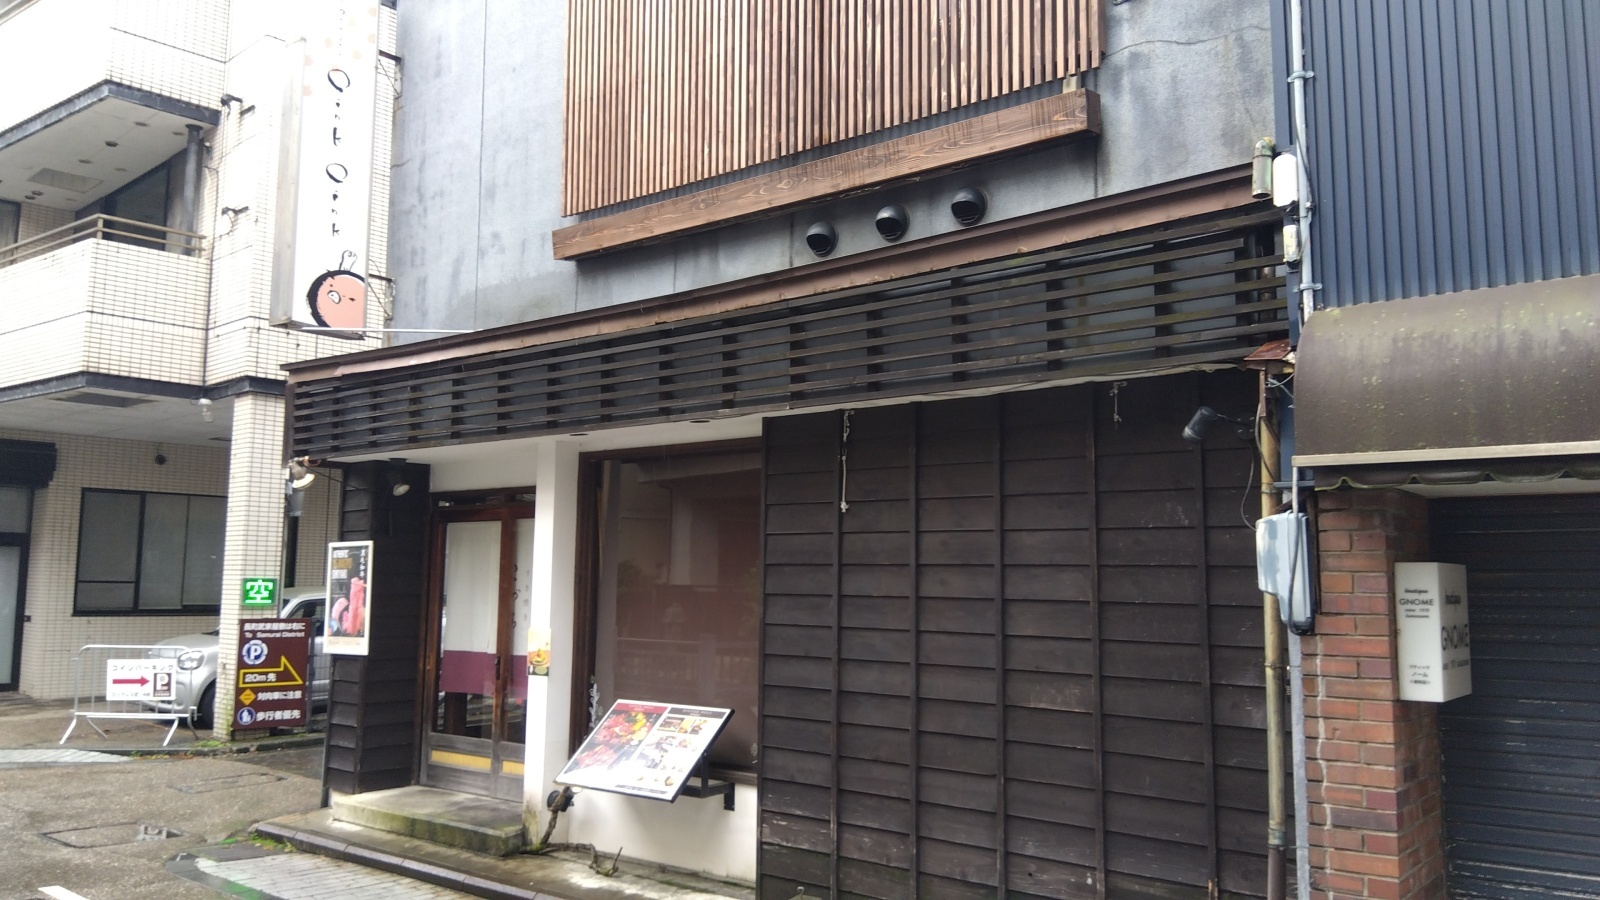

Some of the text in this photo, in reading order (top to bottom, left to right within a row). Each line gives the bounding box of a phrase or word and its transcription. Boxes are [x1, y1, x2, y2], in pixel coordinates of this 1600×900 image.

[325, 68, 351, 237] Oink Oink
[245, 579, 274, 604] 空
[1400, 598, 1434, 606] GNOME
[1441, 623, 1469, 651] GNOME
[250, 645, 261, 660] P
[112, 664, 174, 672] コインパーキング
[257, 691, 302, 701] 対向車に注意
[256, 709, 302, 721] 歩行者優先
